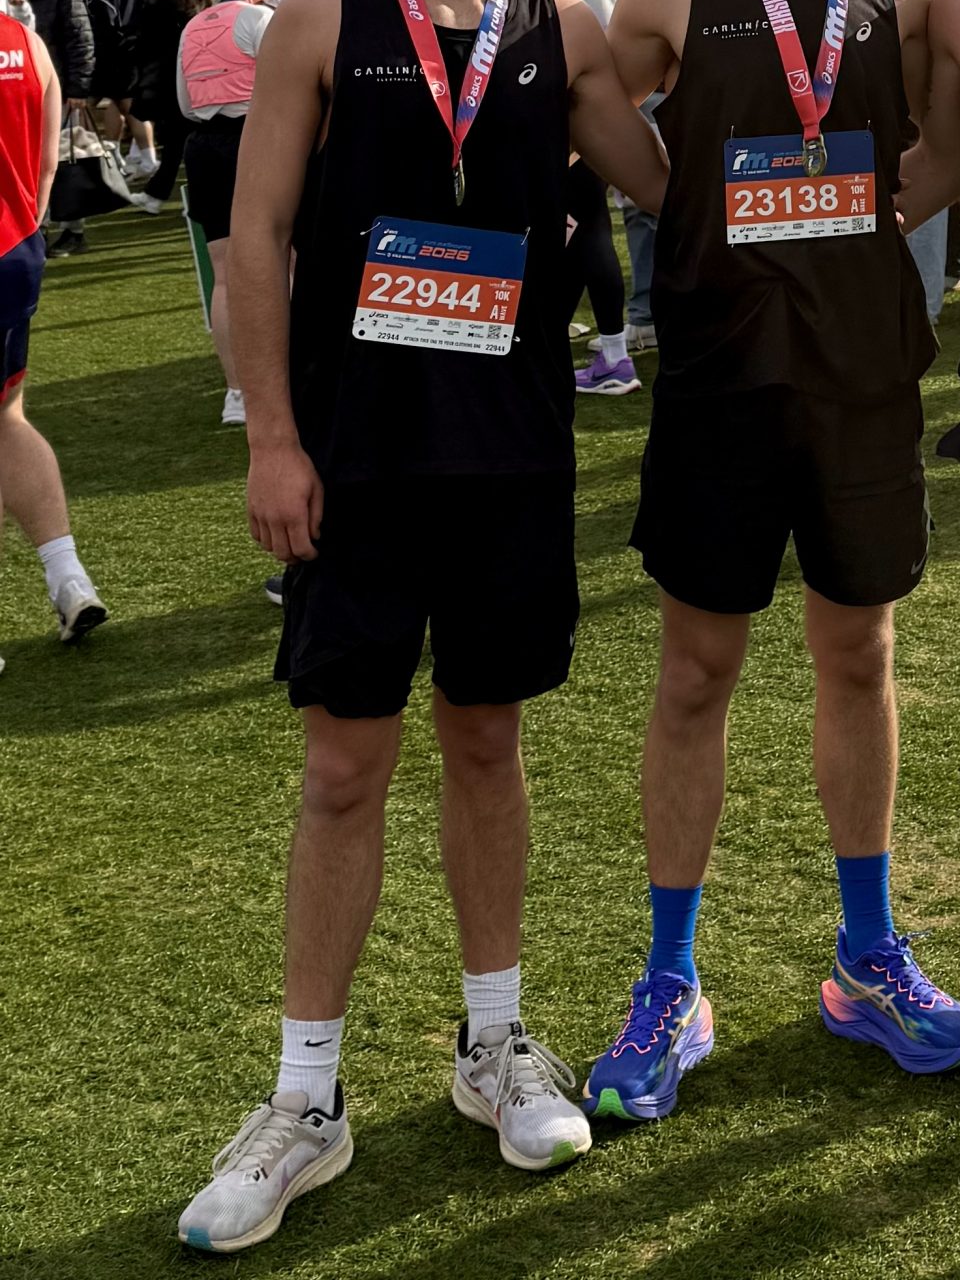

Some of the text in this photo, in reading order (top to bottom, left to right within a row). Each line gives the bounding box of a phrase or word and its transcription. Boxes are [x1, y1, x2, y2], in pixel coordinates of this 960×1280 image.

[490, 7, 502, 31] run
[825, 51, 836, 75] asics
[470, 75, 483, 98] asics
[771, 157, 805, 168] 202
[850, 184, 866, 195] 10K
[734, 183, 839, 218] 23138
[419, 245, 471, 261] 2026
[367, 272, 481, 313] 22944
[495, 289, 511, 301] 10K
[489, 304, 498, 320] A
[377, 331, 400, 341] 22944
[485, 343, 506, 352] 22944
